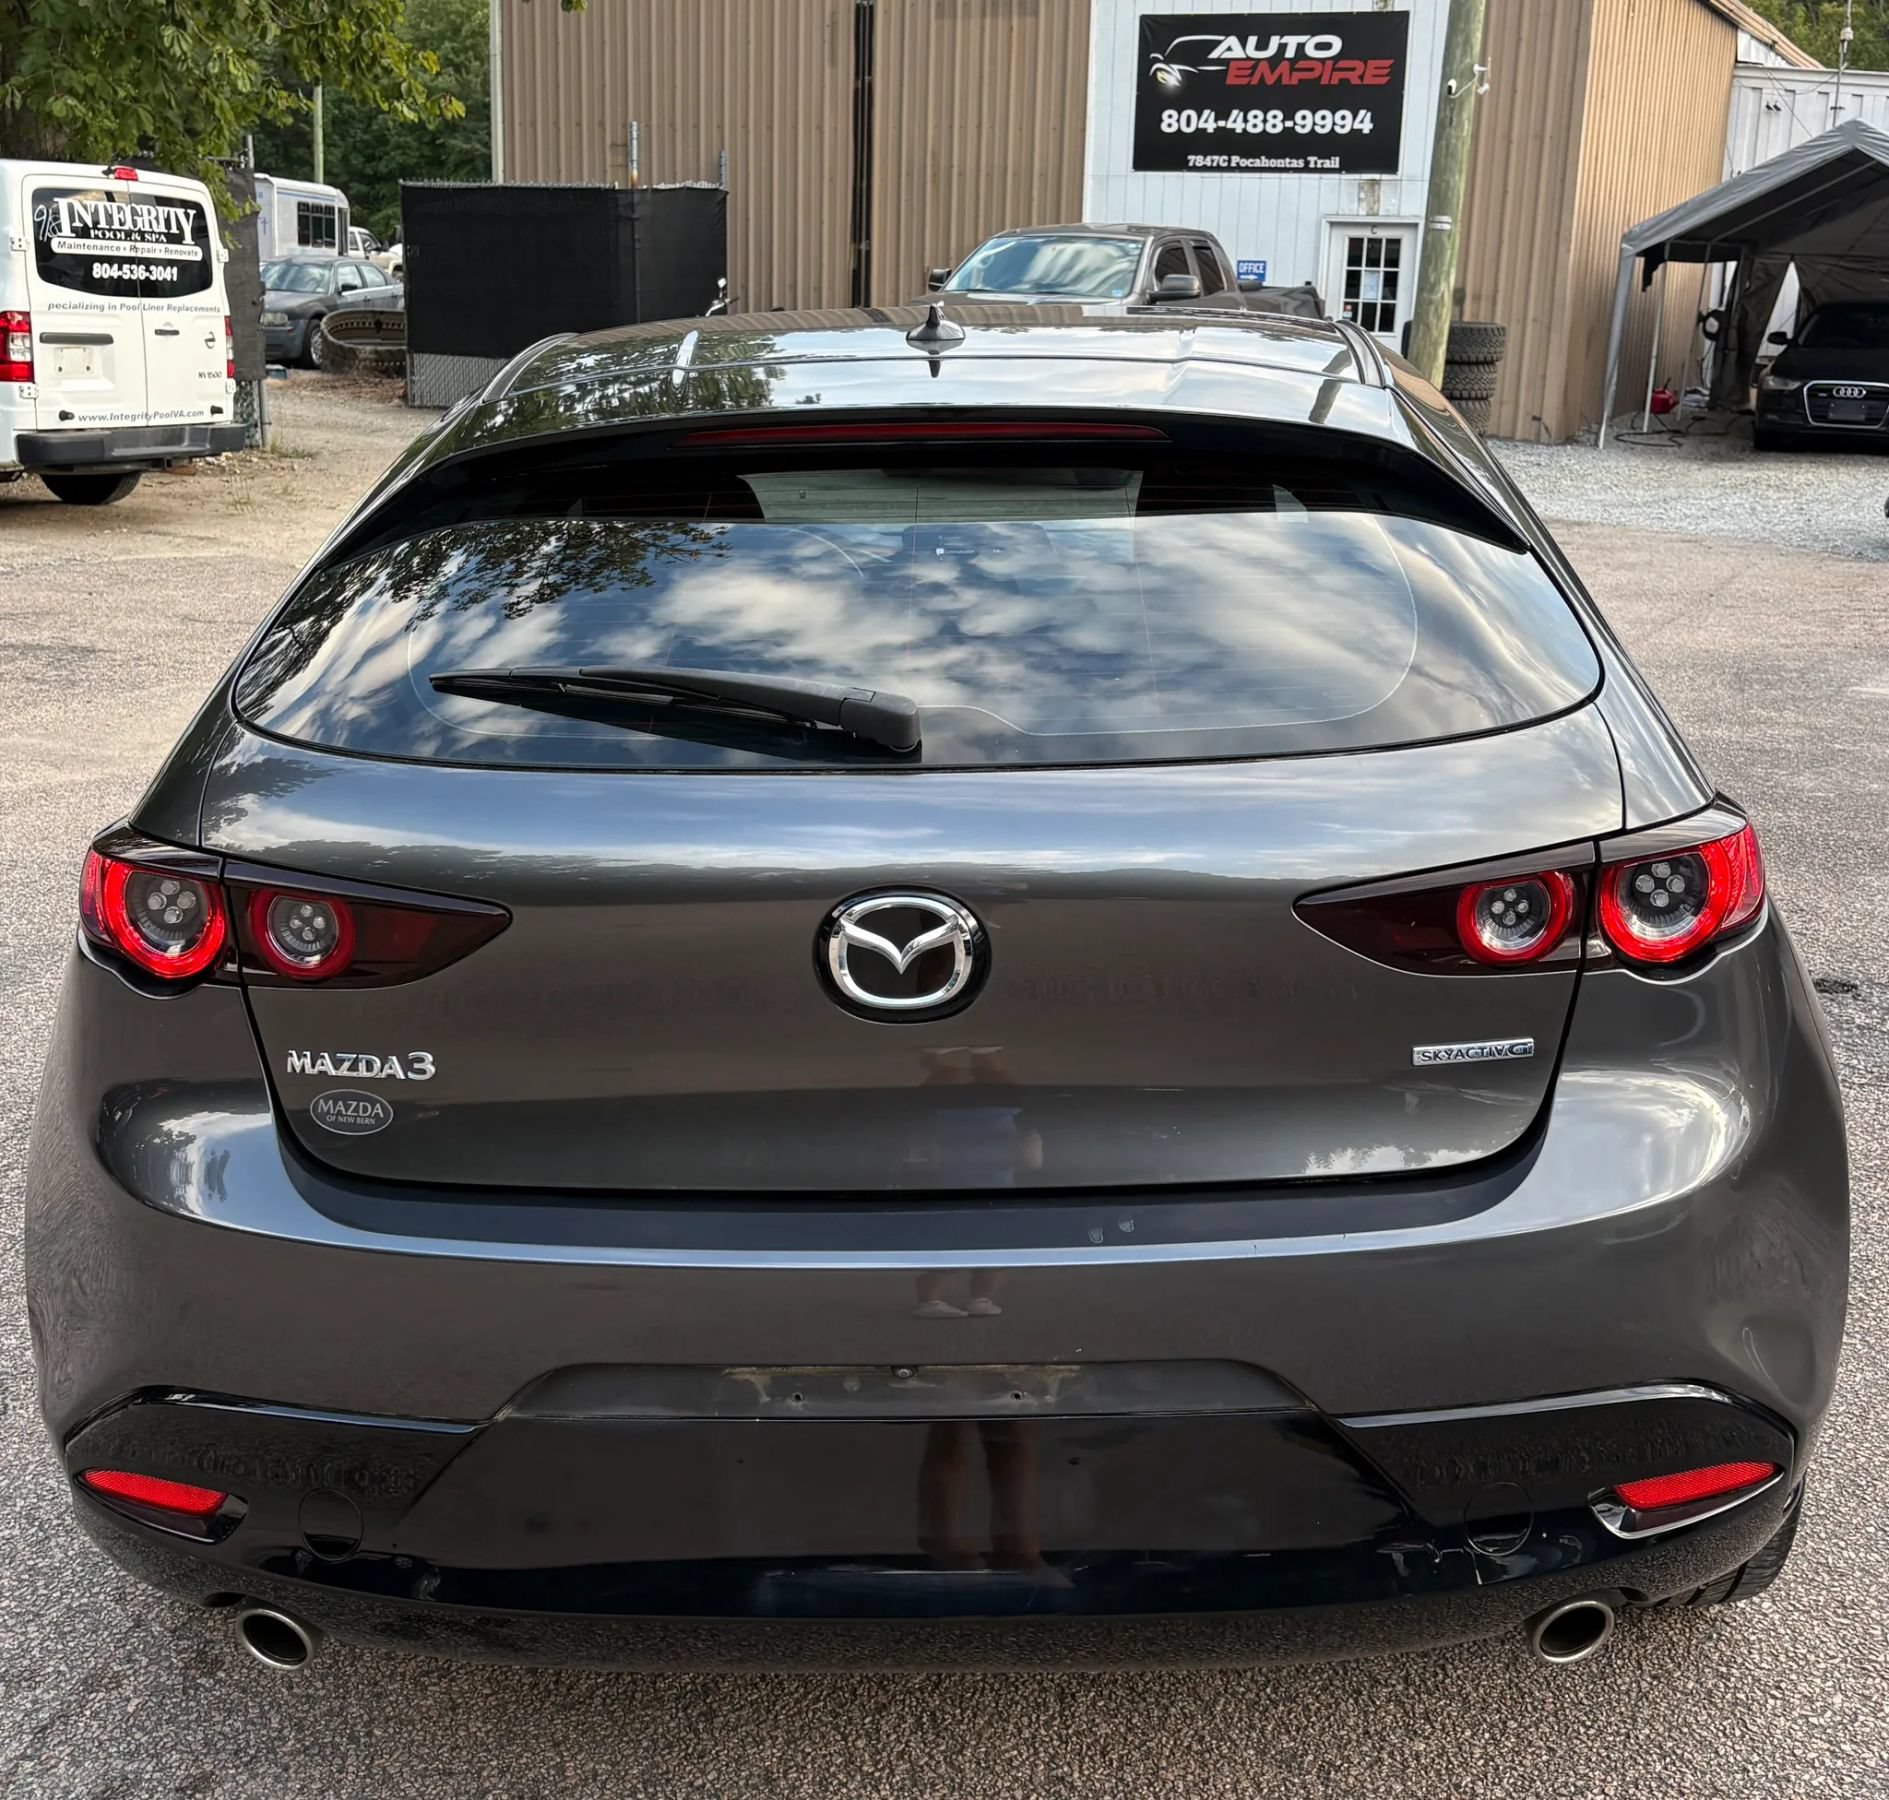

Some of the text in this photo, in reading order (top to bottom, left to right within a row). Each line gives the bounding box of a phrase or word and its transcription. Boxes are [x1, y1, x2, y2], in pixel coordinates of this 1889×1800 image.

[1207, 34, 1343, 59] AUTO
[1225, 60, 1395, 85] EMPIRE
[1160, 109, 1374, 134] 804-488-9994
[1230, 155, 1305, 168] Pocahontas
[1307, 156, 1340, 169] Trail
[53, 197, 197, 245] INTEGRITY
[90, 229, 130, 241] POOL
[144, 232, 167, 243] SPA
[57, 240, 199, 257] Maintenance Repair Renovate
[92, 262, 178, 281] 804-536-3041
[1238, 262, 1265, 274] OFFICE
[107, 302, 117, 311] in
[119, 302, 140, 311] Pool
[142, 303, 164, 311] Liner
[166, 303, 221, 314] Replacements
[78, 408, 205, 422] www.IntegrityPoolVA.com
[317, 1098, 384, 1118] MAZDA
[337, 1115, 355, 1124] NEW
[356, 1117, 376, 1125] BERN
